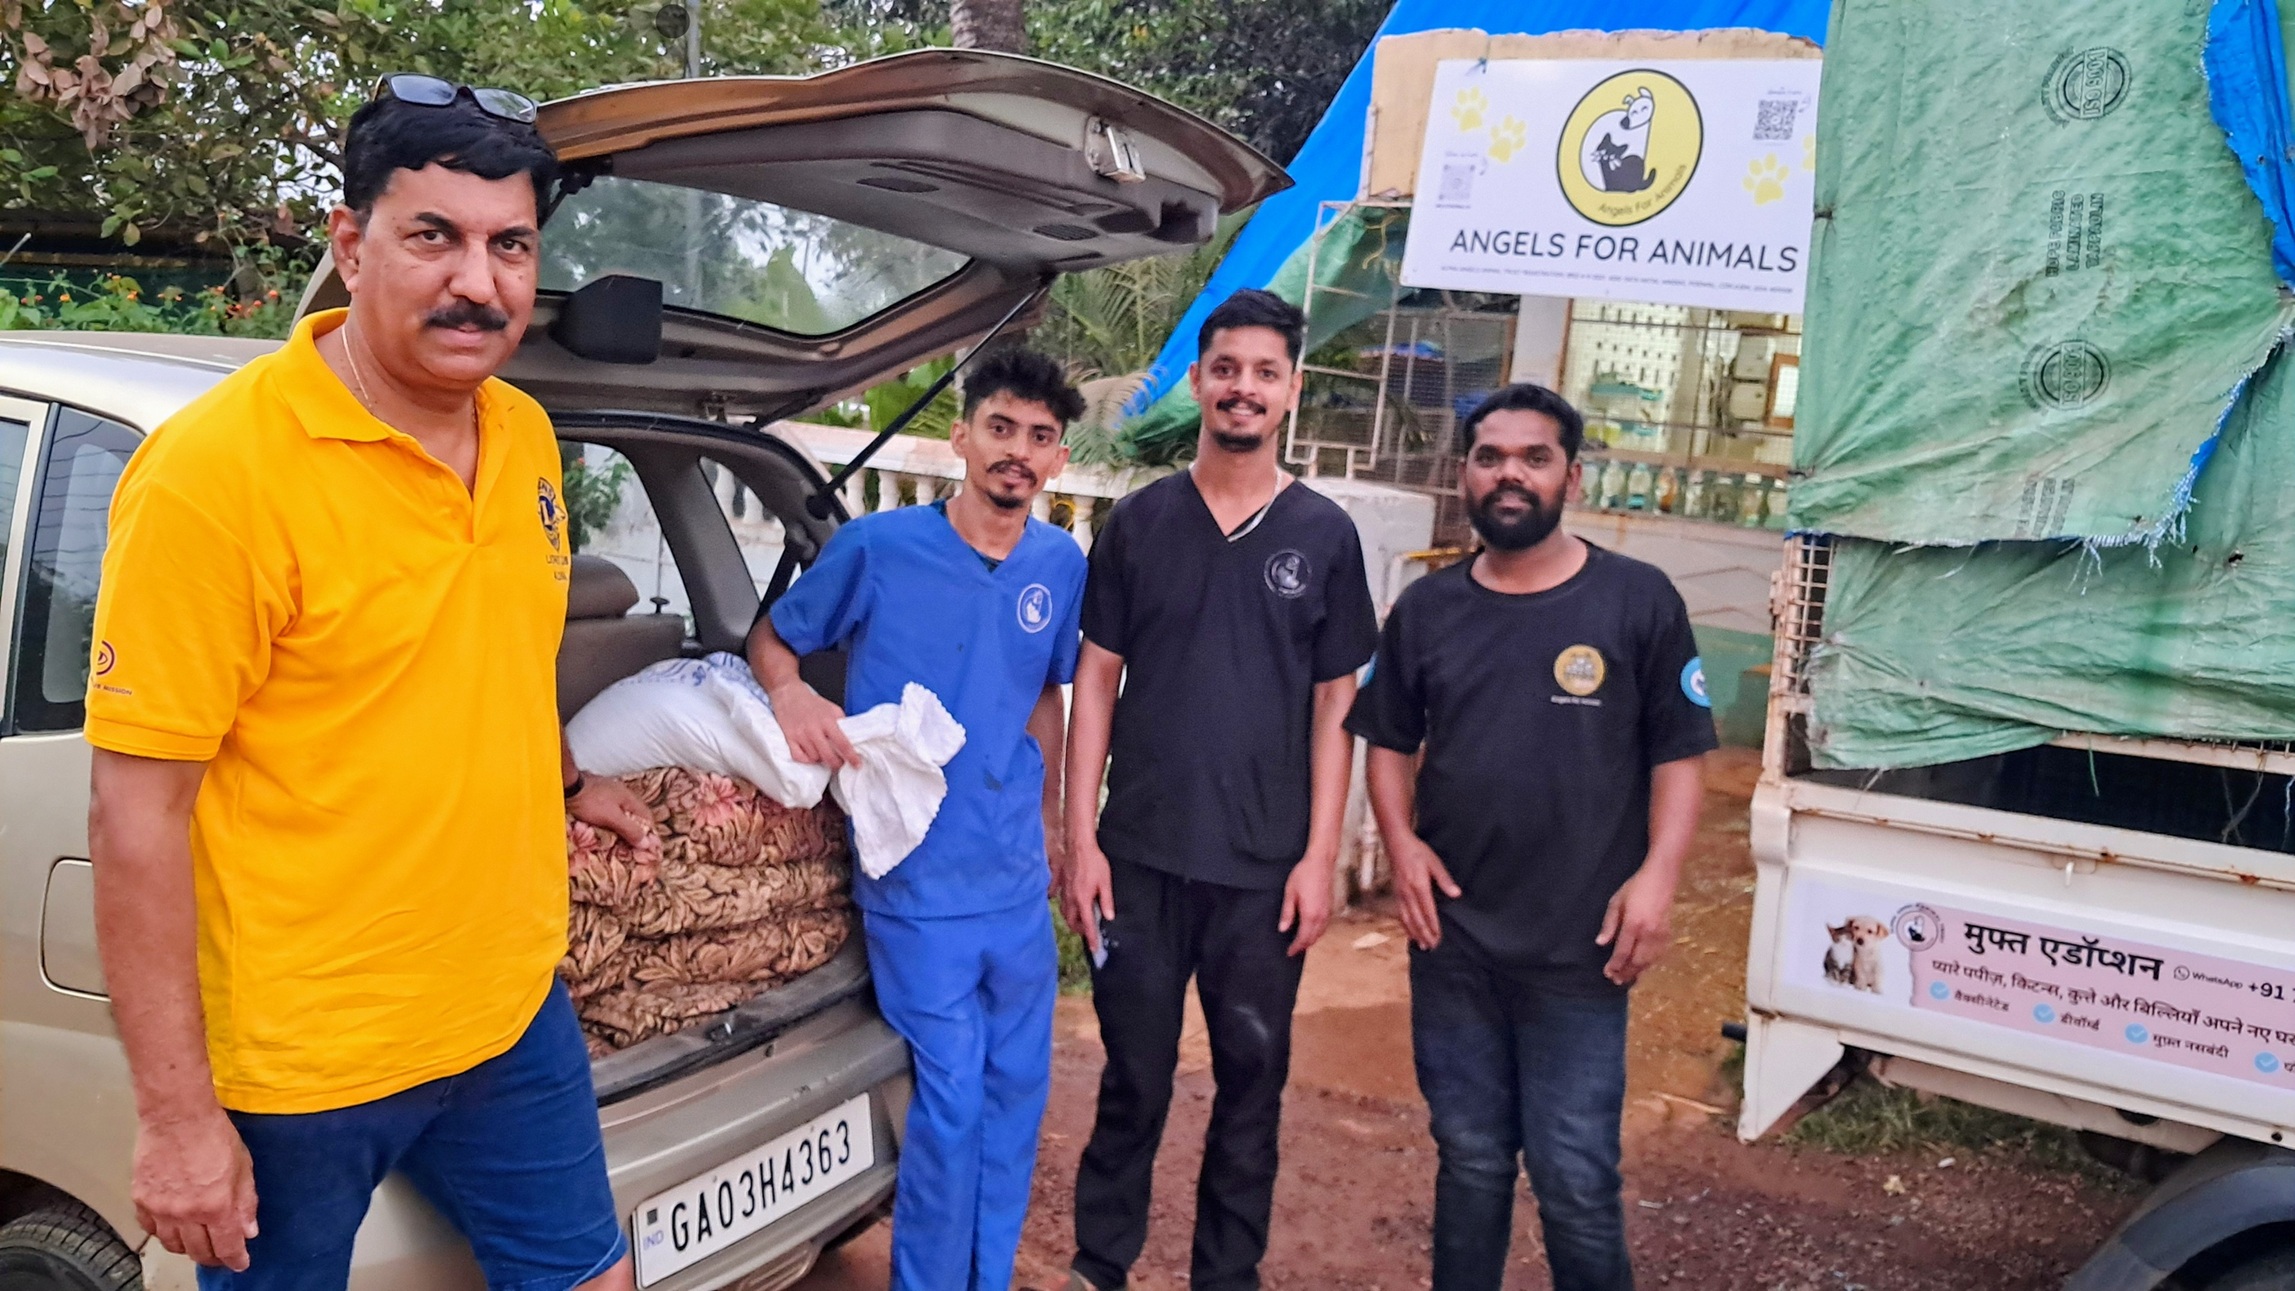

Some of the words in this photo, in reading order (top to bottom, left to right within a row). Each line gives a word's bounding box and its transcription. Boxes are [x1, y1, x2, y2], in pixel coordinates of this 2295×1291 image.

[2085, 51, 2105, 88] 9001
[2083, 89, 2102, 116] ISO
[2049, 190, 2066, 239] FABRIC
[2066, 194, 2084, 271] LAMINATED
[2085, 193, 2104, 269] TARPAULIN
[1450, 229, 1566, 258] ANGELS
[1575, 234, 1638, 263] FOR
[1648, 238, 1798, 273] ANIMALS
[1964, 922, 2031, 954] मुफ्त
[2039, 936, 2164, 981] एडॉप्शन
[2192, 971, 2243, 989] WhatsApp
[2248, 982, 2285, 1000] +91
[2100, 993, 2131, 1011] और
[2203, 1016, 2244, 1035] अपने
[2246, 1024, 2272, 1043] नए
[671, 1120, 851, 1252] GA03H4363
[643, 1230, 665, 1250] IND
